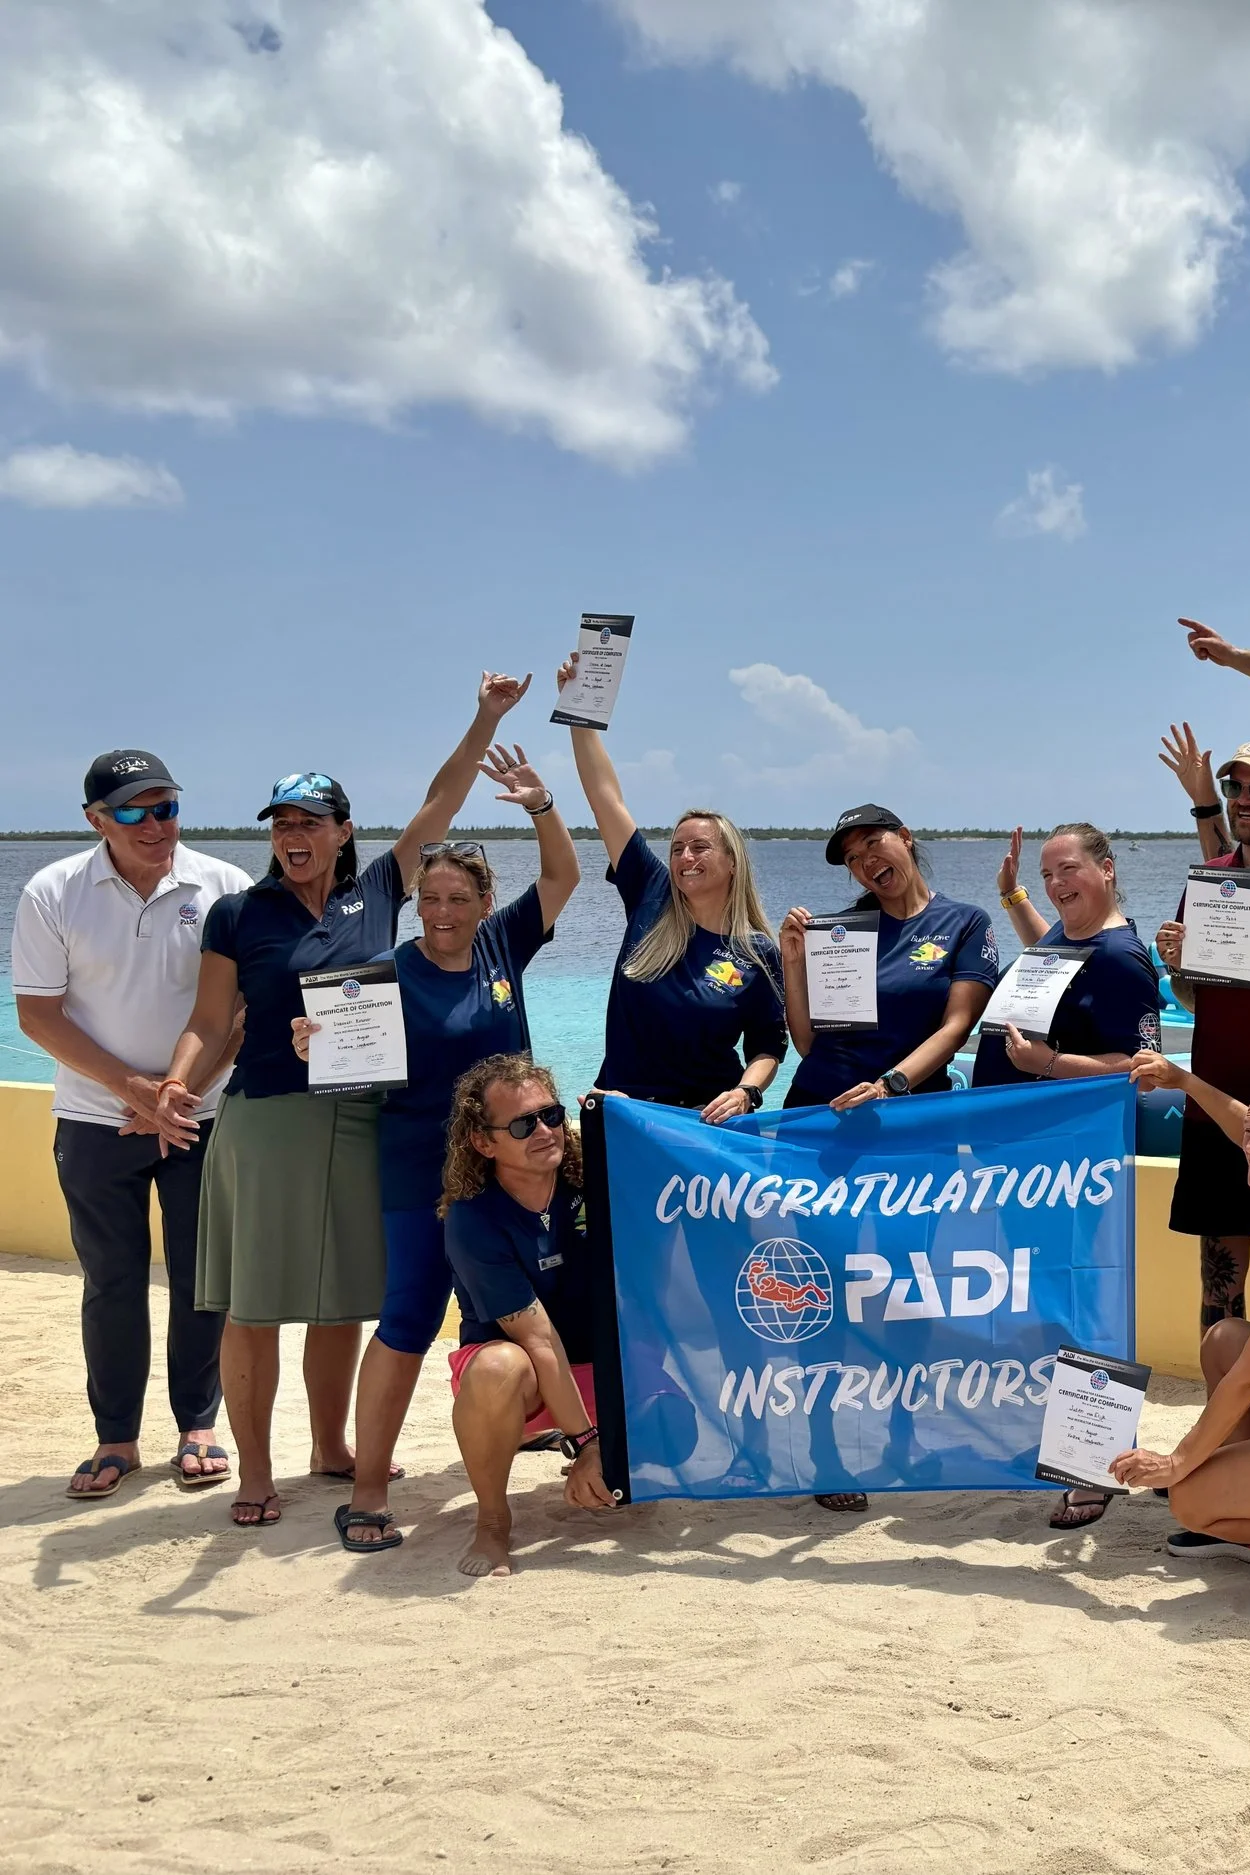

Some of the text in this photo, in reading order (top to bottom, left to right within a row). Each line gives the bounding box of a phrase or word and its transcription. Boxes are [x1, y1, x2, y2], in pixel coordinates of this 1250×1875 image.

[112, 760, 149, 773] RELAX
[300, 789, 323, 800] PADI
[316, 1007, 348, 1017] CERTIFICATE
[358, 1001, 392, 1010] COMPLETION
[654, 1157, 1123, 1225] CONGRATULATIONS
[718, 1352, 1060, 1420] INSTRUCTORS
[1059, 1388, 1088, 1401] CERTIFICATE
[1098, 1398, 1132, 1412] COMPLETION
[1041, 1472, 1094, 1488] INSTRUCTOR DEVELOPMENT
